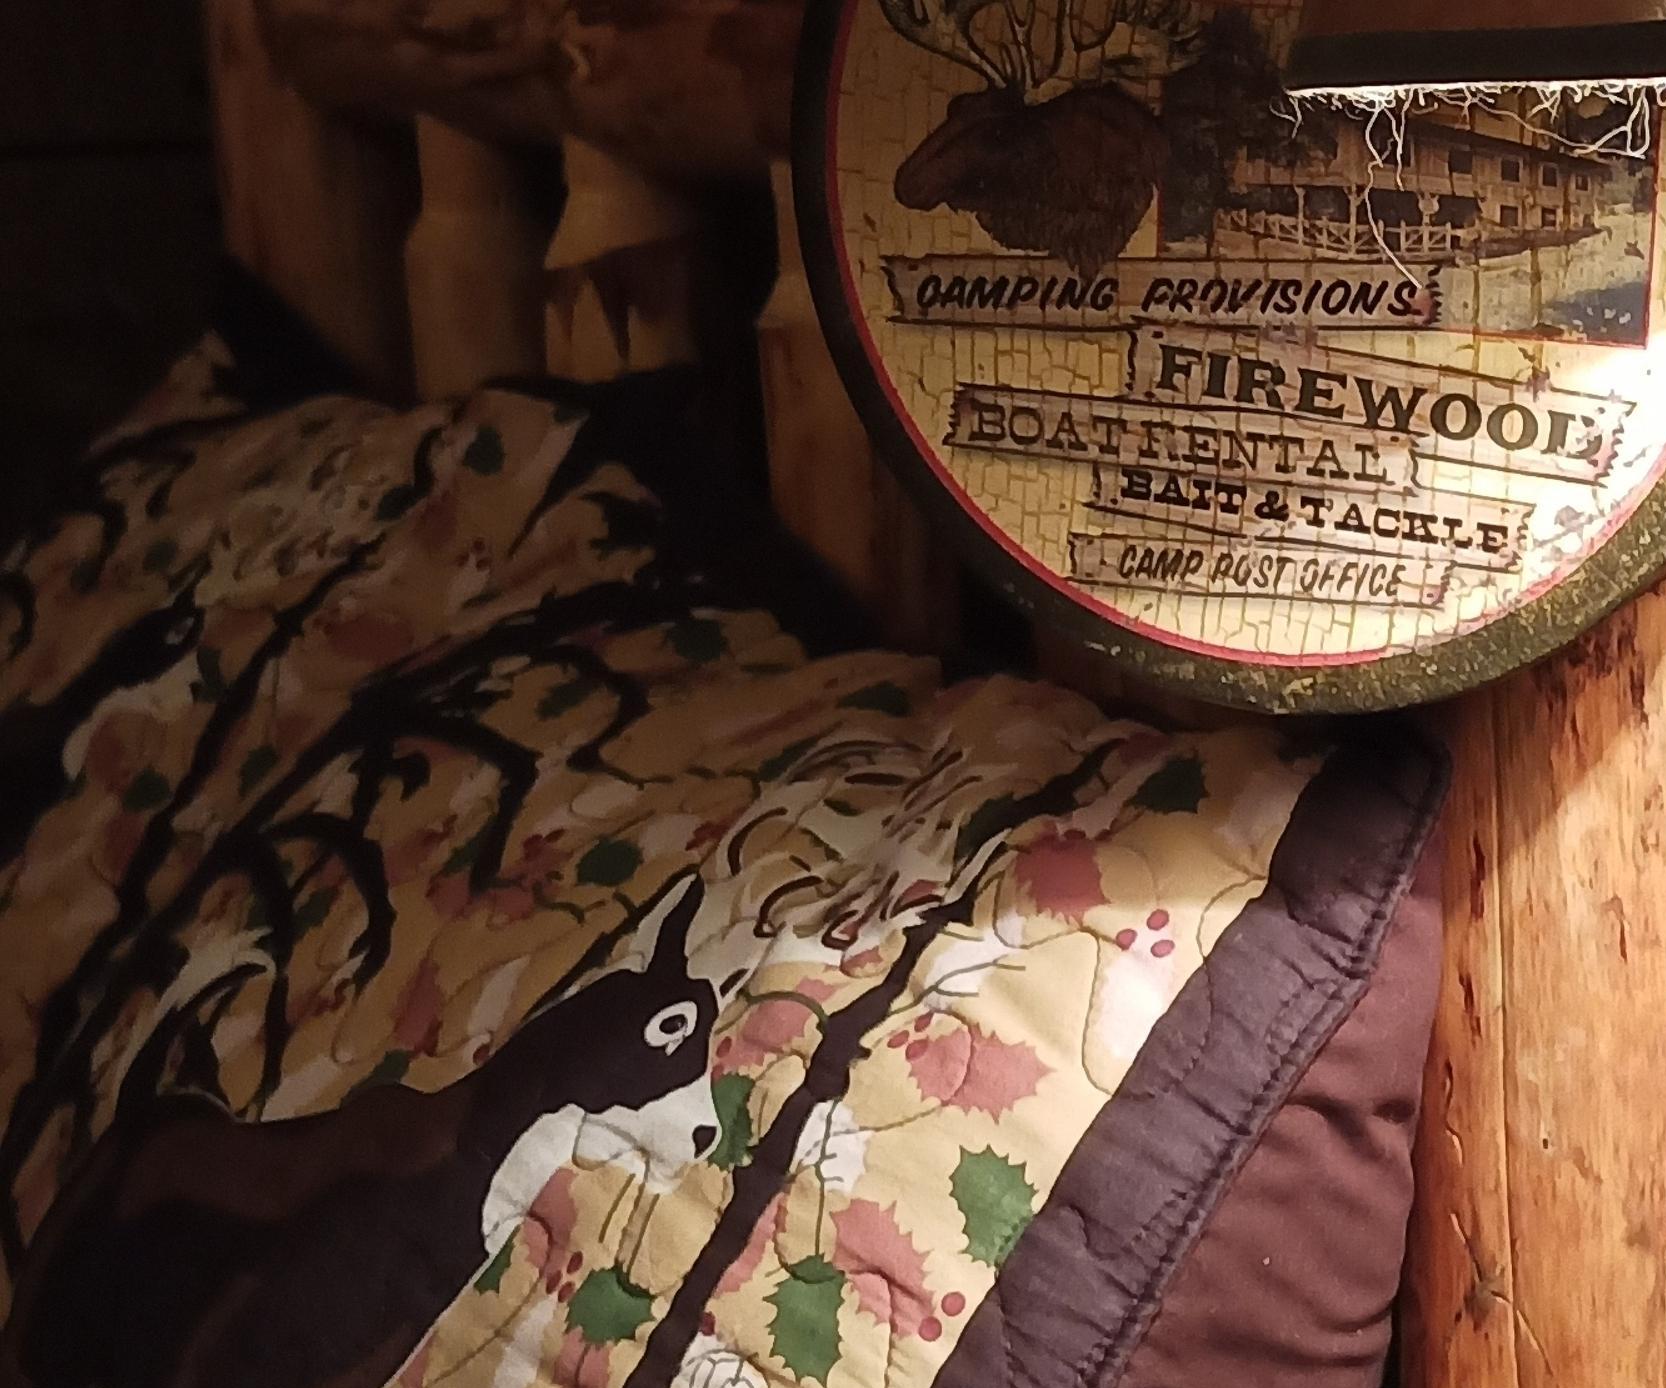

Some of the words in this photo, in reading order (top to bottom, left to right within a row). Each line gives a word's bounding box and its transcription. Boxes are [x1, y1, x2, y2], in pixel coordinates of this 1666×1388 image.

[916, 274, 1119, 312] CAMPING
[1140, 276, 1422, 316] PROVISIONS
[1155, 343, 1603, 461] FIREWOOD
[968, 397, 1128, 455] BOAT
[1137, 420, 1394, 484] RENTAL
[1120, 468, 1248, 515] BAIT
[1253, 489, 1290, 522] &
[1300, 495, 1509, 554] TACKLE
[1118, 544, 1205, 582] CAMP
[1210, 551, 1297, 595] POST
[1299, 557, 1406, 597] OFFICE
